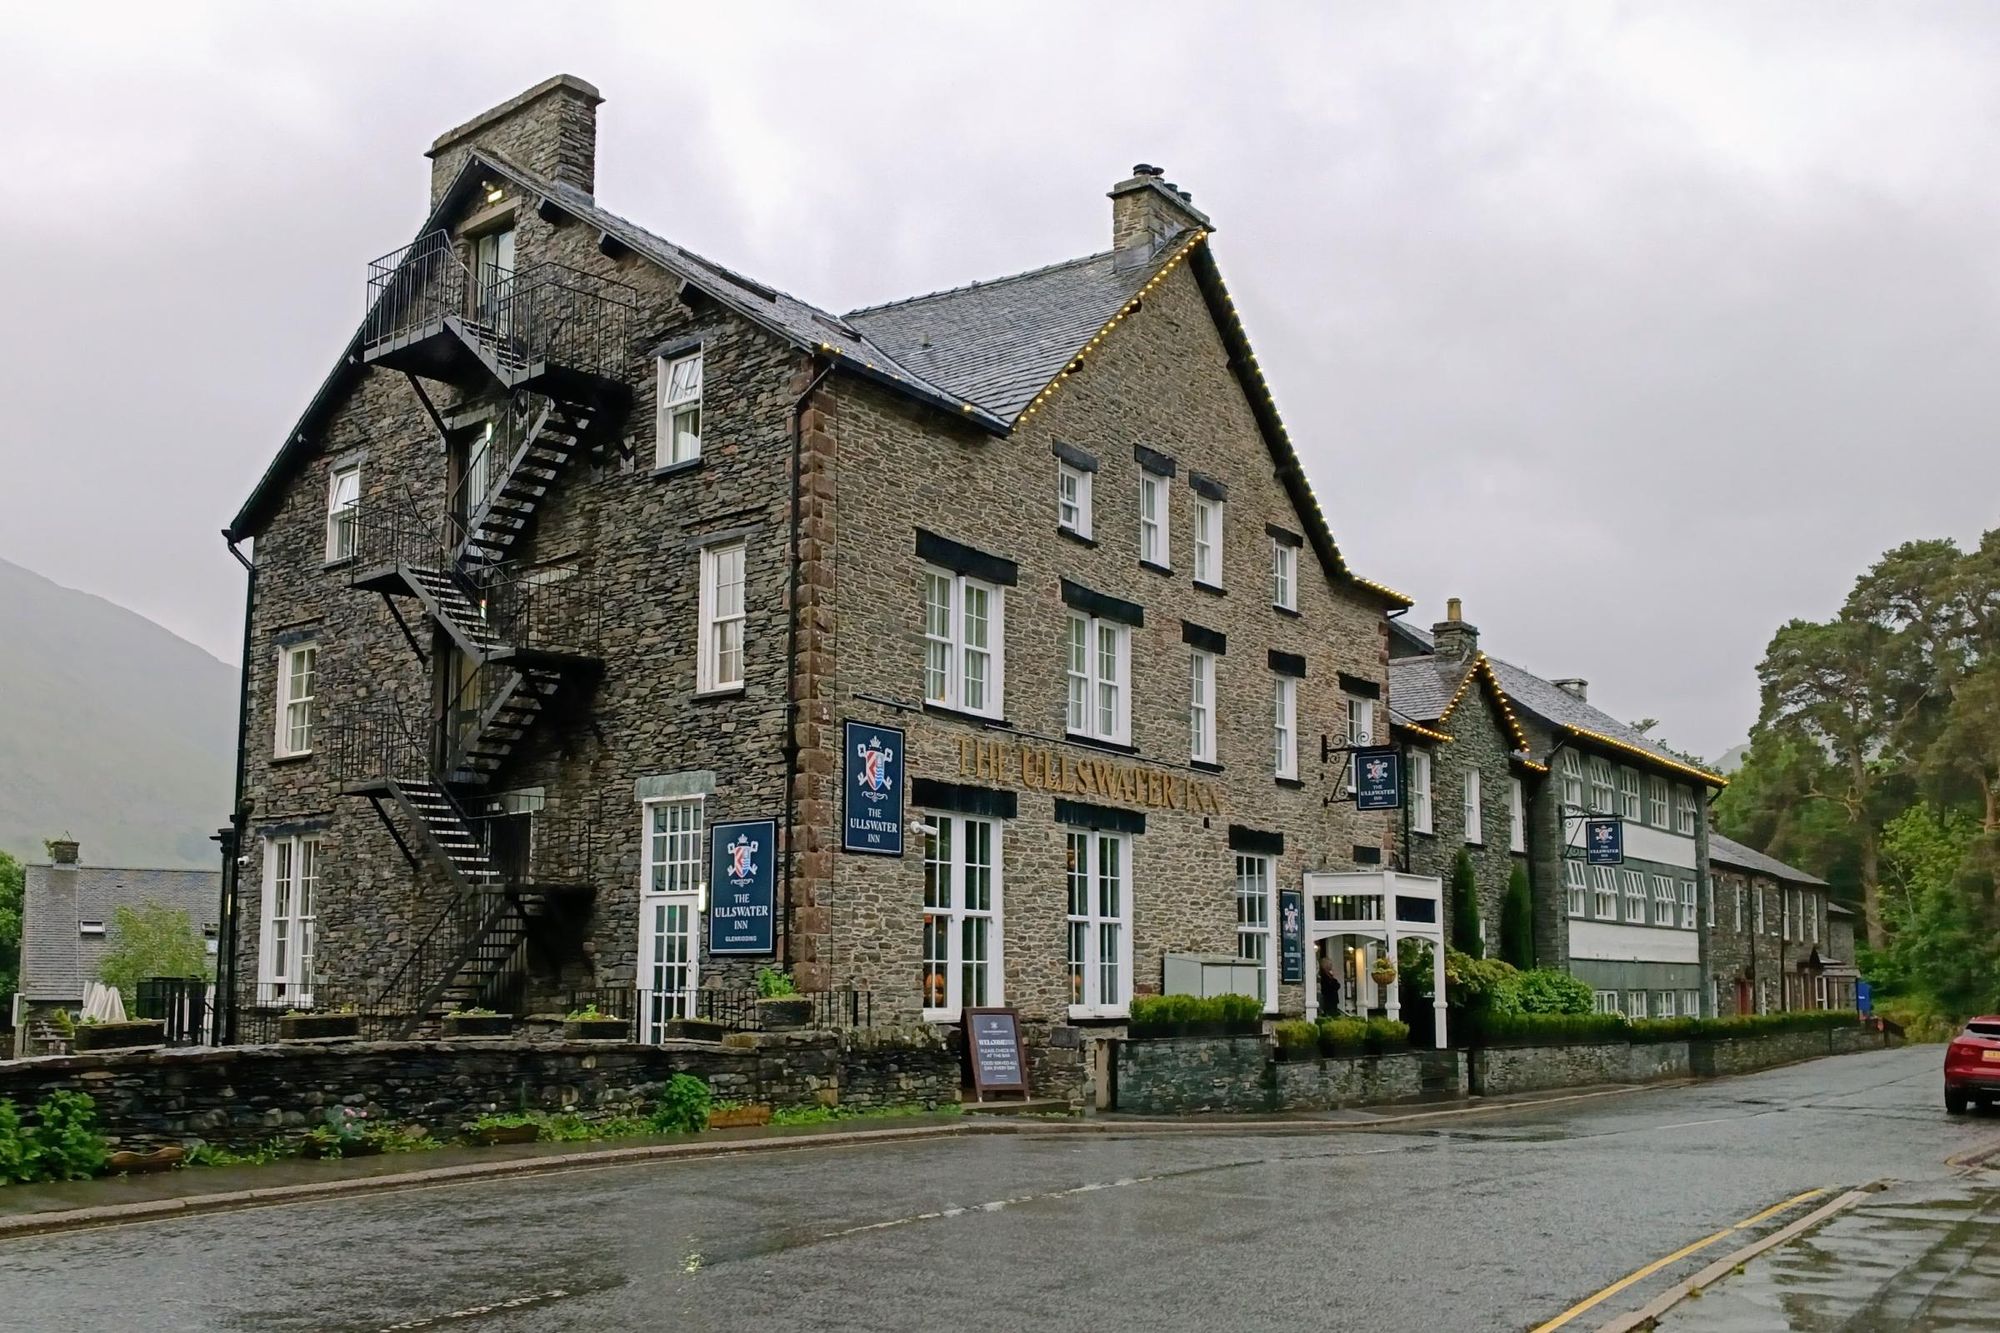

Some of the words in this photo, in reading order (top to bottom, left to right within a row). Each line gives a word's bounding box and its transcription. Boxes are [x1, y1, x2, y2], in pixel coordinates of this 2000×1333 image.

[955, 735, 1010, 782] THE
[1022, 747, 1176, 810] ULLSWATER
[1184, 778, 1227, 815] INN
[867, 808, 882, 818] THE
[850, 818, 898, 833] ULLSWATER
[867, 834, 881, 844] INN
[734, 894, 750, 903] THE
[715, 906, 768, 917] ULLSWATER
[734, 920, 748, 930] INN
